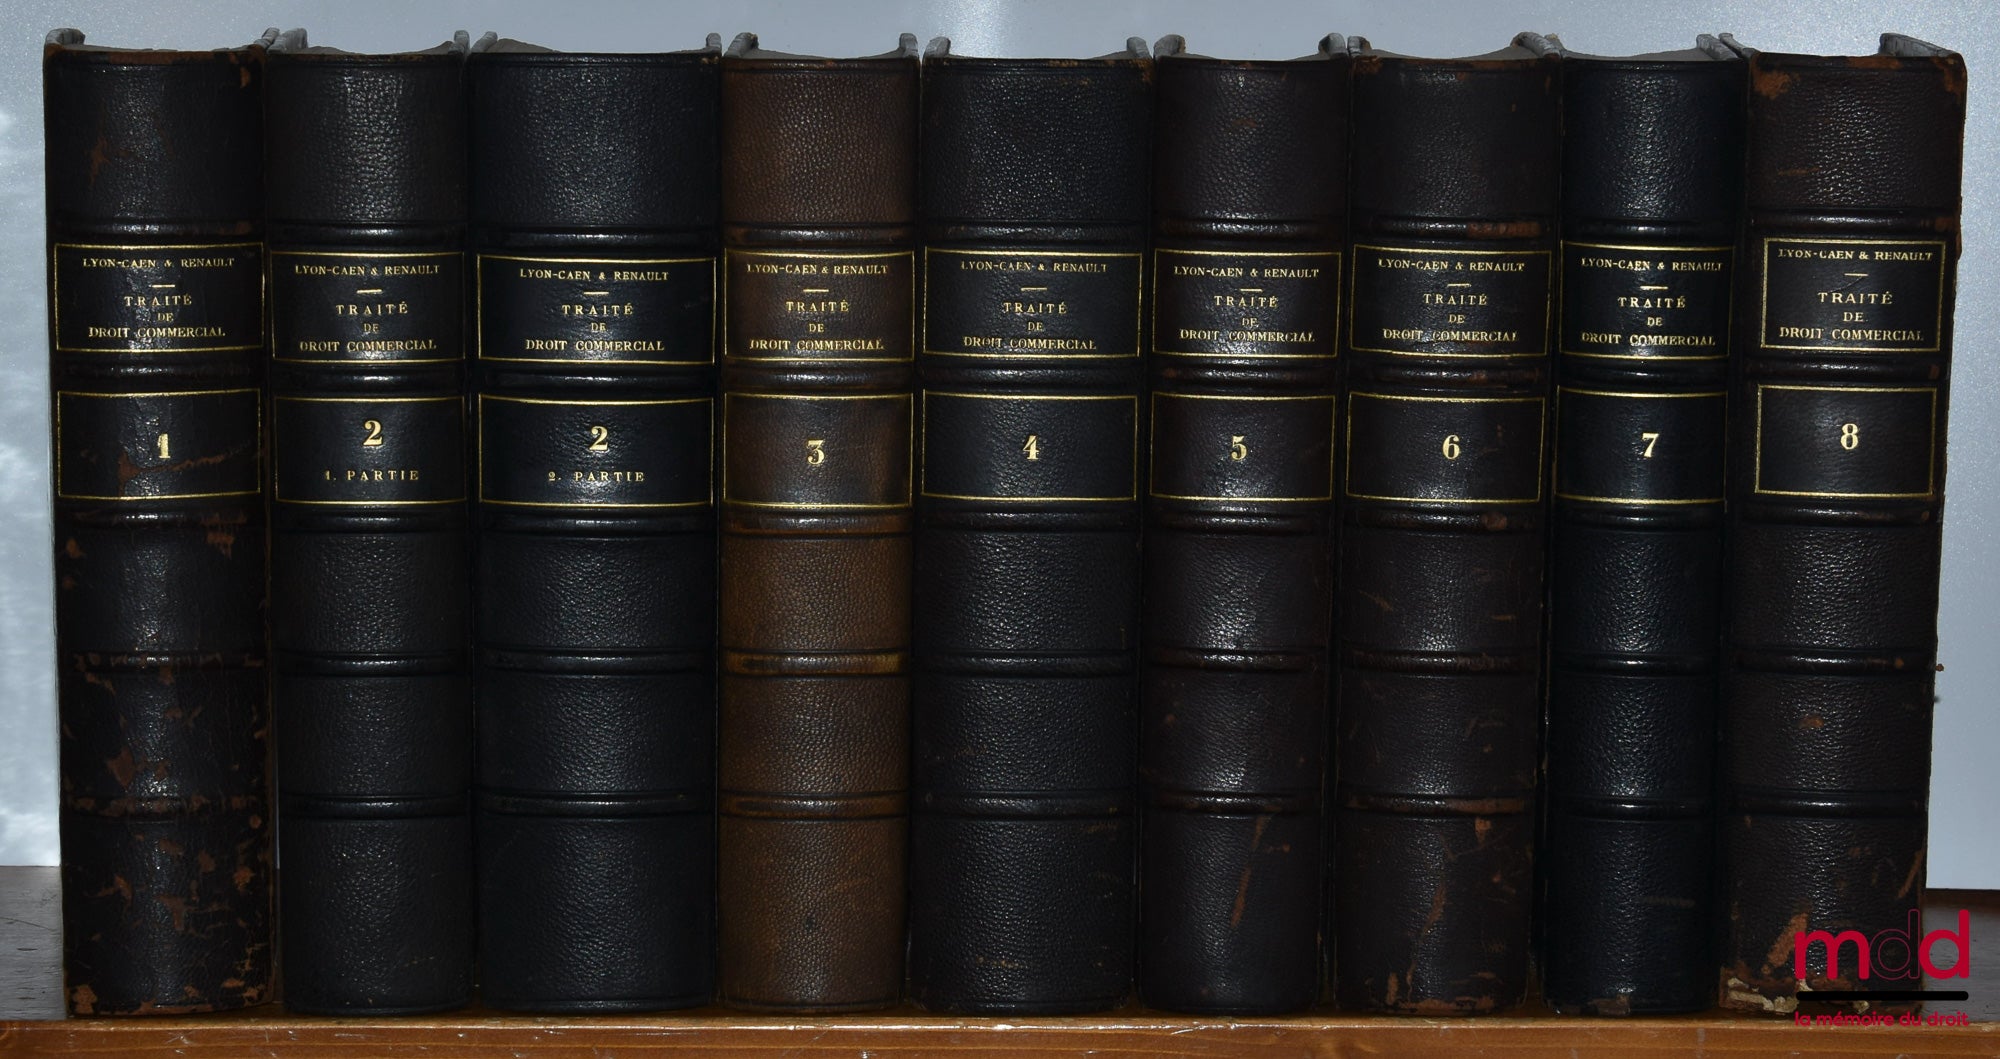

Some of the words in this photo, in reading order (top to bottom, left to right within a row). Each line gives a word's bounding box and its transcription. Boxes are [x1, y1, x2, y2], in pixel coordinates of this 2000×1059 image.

[1778, 249, 1853, 260] LYON-CAEN
[1859, 251, 1869, 260] &
[1875, 251, 1933, 261] RENAULT
[83, 258, 158, 268] LYON-CAEN
[164, 259, 172, 267] &
[181, 258, 235, 267] RENAULT
[747, 264, 817, 274] LYON-CAEN
[822, 266, 829, 274] &
[834, 264, 889, 274] RENAULT
[961, 261, 1032, 272] LYON-CAEN
[1037, 263, 1045, 271] &
[1053, 262, 1107, 273] RENAULT
[1378, 259, 1448, 270] LYON-CAEN
[1455, 262, 1463, 270] &
[1469, 261, 1525, 272] RENAULT
[1582, 258, 1651, 270] LYON-CAEN
[1657, 262, 1666, 270] &
[1672, 261, 1723, 271] RENAULT
[295, 265, 365, 276] LYON-CAEN
[371, 267, 379, 275] &
[385, 265, 440, 275] RENAULT
[520, 269, 591, 280] LYON-CAEN
[614, 271, 669, 281] RENAULT
[1174, 266, 1244, 277] LYON-CAEN
[1250, 269, 1258, 277] &
[1264, 268, 1319, 278] RENAULT
[124, 295, 192, 306] TRAITÉ
[1214, 295, 1279, 308] TRAITÉ
[1423, 293, 1487, 306] TRAITÉ
[1618, 295, 1686, 308] TRAITÉ
[1818, 291, 1893, 305] TRAITÉ
[336, 301, 408, 315] TRAITÉ
[562, 303, 634, 315] TRAITÉ
[786, 300, 849, 312] TRAITÉ
[1003, 302, 1068, 314] TRAITÉ
[157, 312, 173, 322] DE
[1242, 317, 1257, 327] DE
[1448, 314, 1465, 323] DE
[1647, 316, 1662, 327] DE
[1843, 311, 1864, 322] DE
[363, 322, 380, 333] DE
[591, 322, 606, 333] DE
[809, 323, 824, 333] DE
[1028, 321, 1043, 331] DE
[88, 327, 130, 338] DROIT
[138, 327, 226, 337] COMMERCIAL
[1180, 329, 1218, 340] DROIT
[1228, 331, 1315, 342] COMMERCIAL
[1383, 329, 1423, 340] DROIT
[1432, 331, 1518, 342] COMMERCIAL
[1780, 327, 1824, 339] DROIT
[1832, 328, 1923, 341] COMMERCIAL
[526, 339, 567, 351] DROIT
[575, 340, 664, 351] COMMERCIAL
[749, 339, 791, 350] DROIT
[797, 340, 885, 350] COMMERCIAL
[963, 336, 1002, 347] DROIT
[1009, 338, 1097, 350] COMMERCIAL
[1582, 333, 1622, 344] DROIT
[1629, 335, 1715, 347] COMMERCIAL
[300, 341, 340, 353] DROIT
[347, 340, 437, 352] COMMERCIAL
[363, 420, 384, 446] 2
[589, 426, 609, 451] 2
[1840, 423, 1859, 449] 8
[157, 434, 171, 459] 1
[1022, 435, 1039, 460] 4
[1231, 435, 1248, 461] 5
[1442, 435, 1461, 460] 6
[1642, 432, 1659, 458] 7
[806, 440, 824, 465] 3
[347, 470, 420, 481] PARTIE
[574, 471, 645, 482] PARTIE
